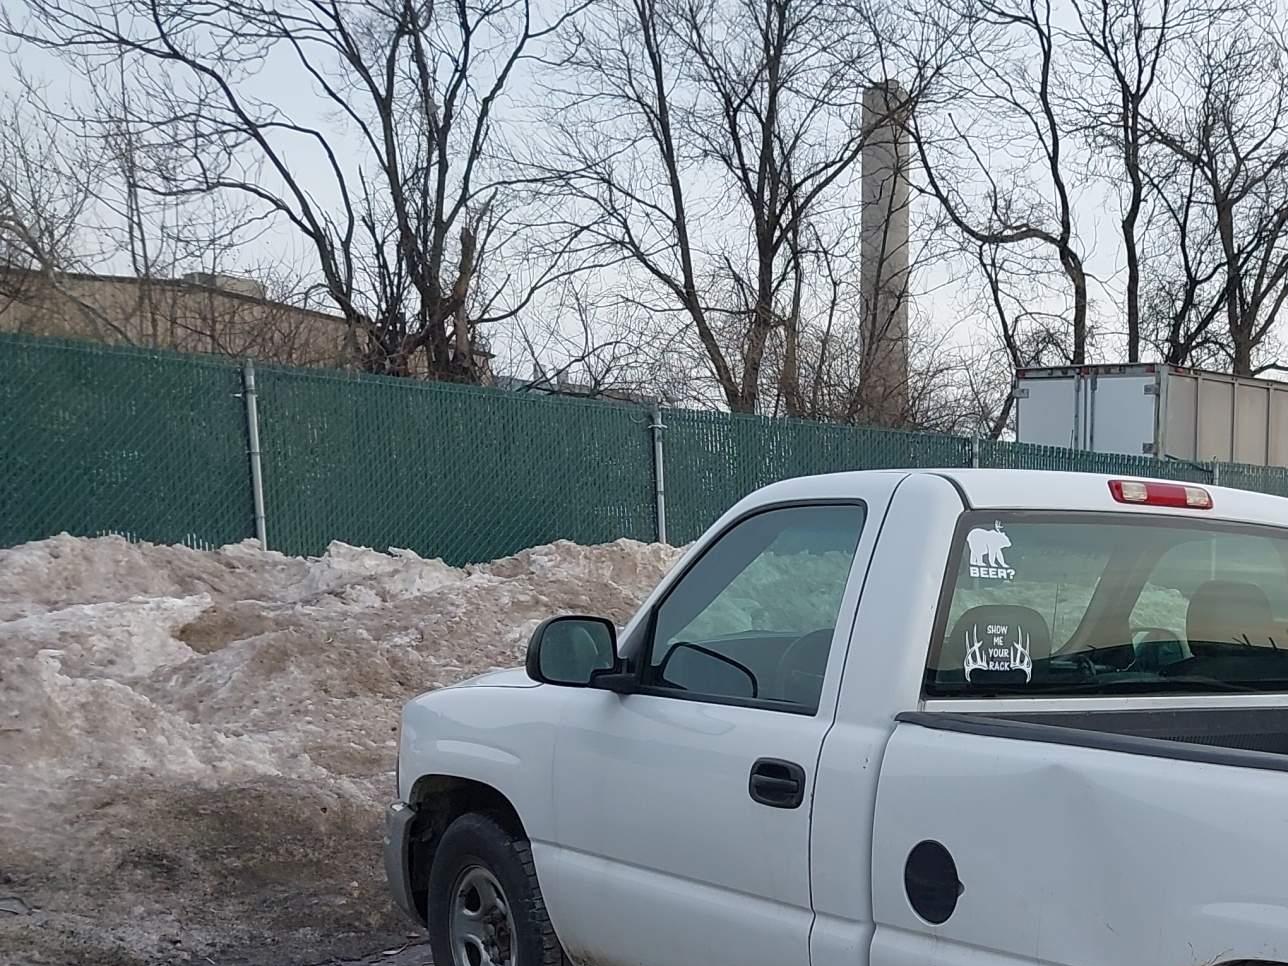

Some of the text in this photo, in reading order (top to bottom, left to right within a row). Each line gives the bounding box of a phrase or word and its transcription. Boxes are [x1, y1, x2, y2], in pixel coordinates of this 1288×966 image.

[969, 567, 1016, 579] BEER?
[986, 625, 1008, 635] SHOW
[993, 637, 1004, 646] ME
[988, 648, 1010, 658] YOUR
[988, 661, 1010, 671] RACK
